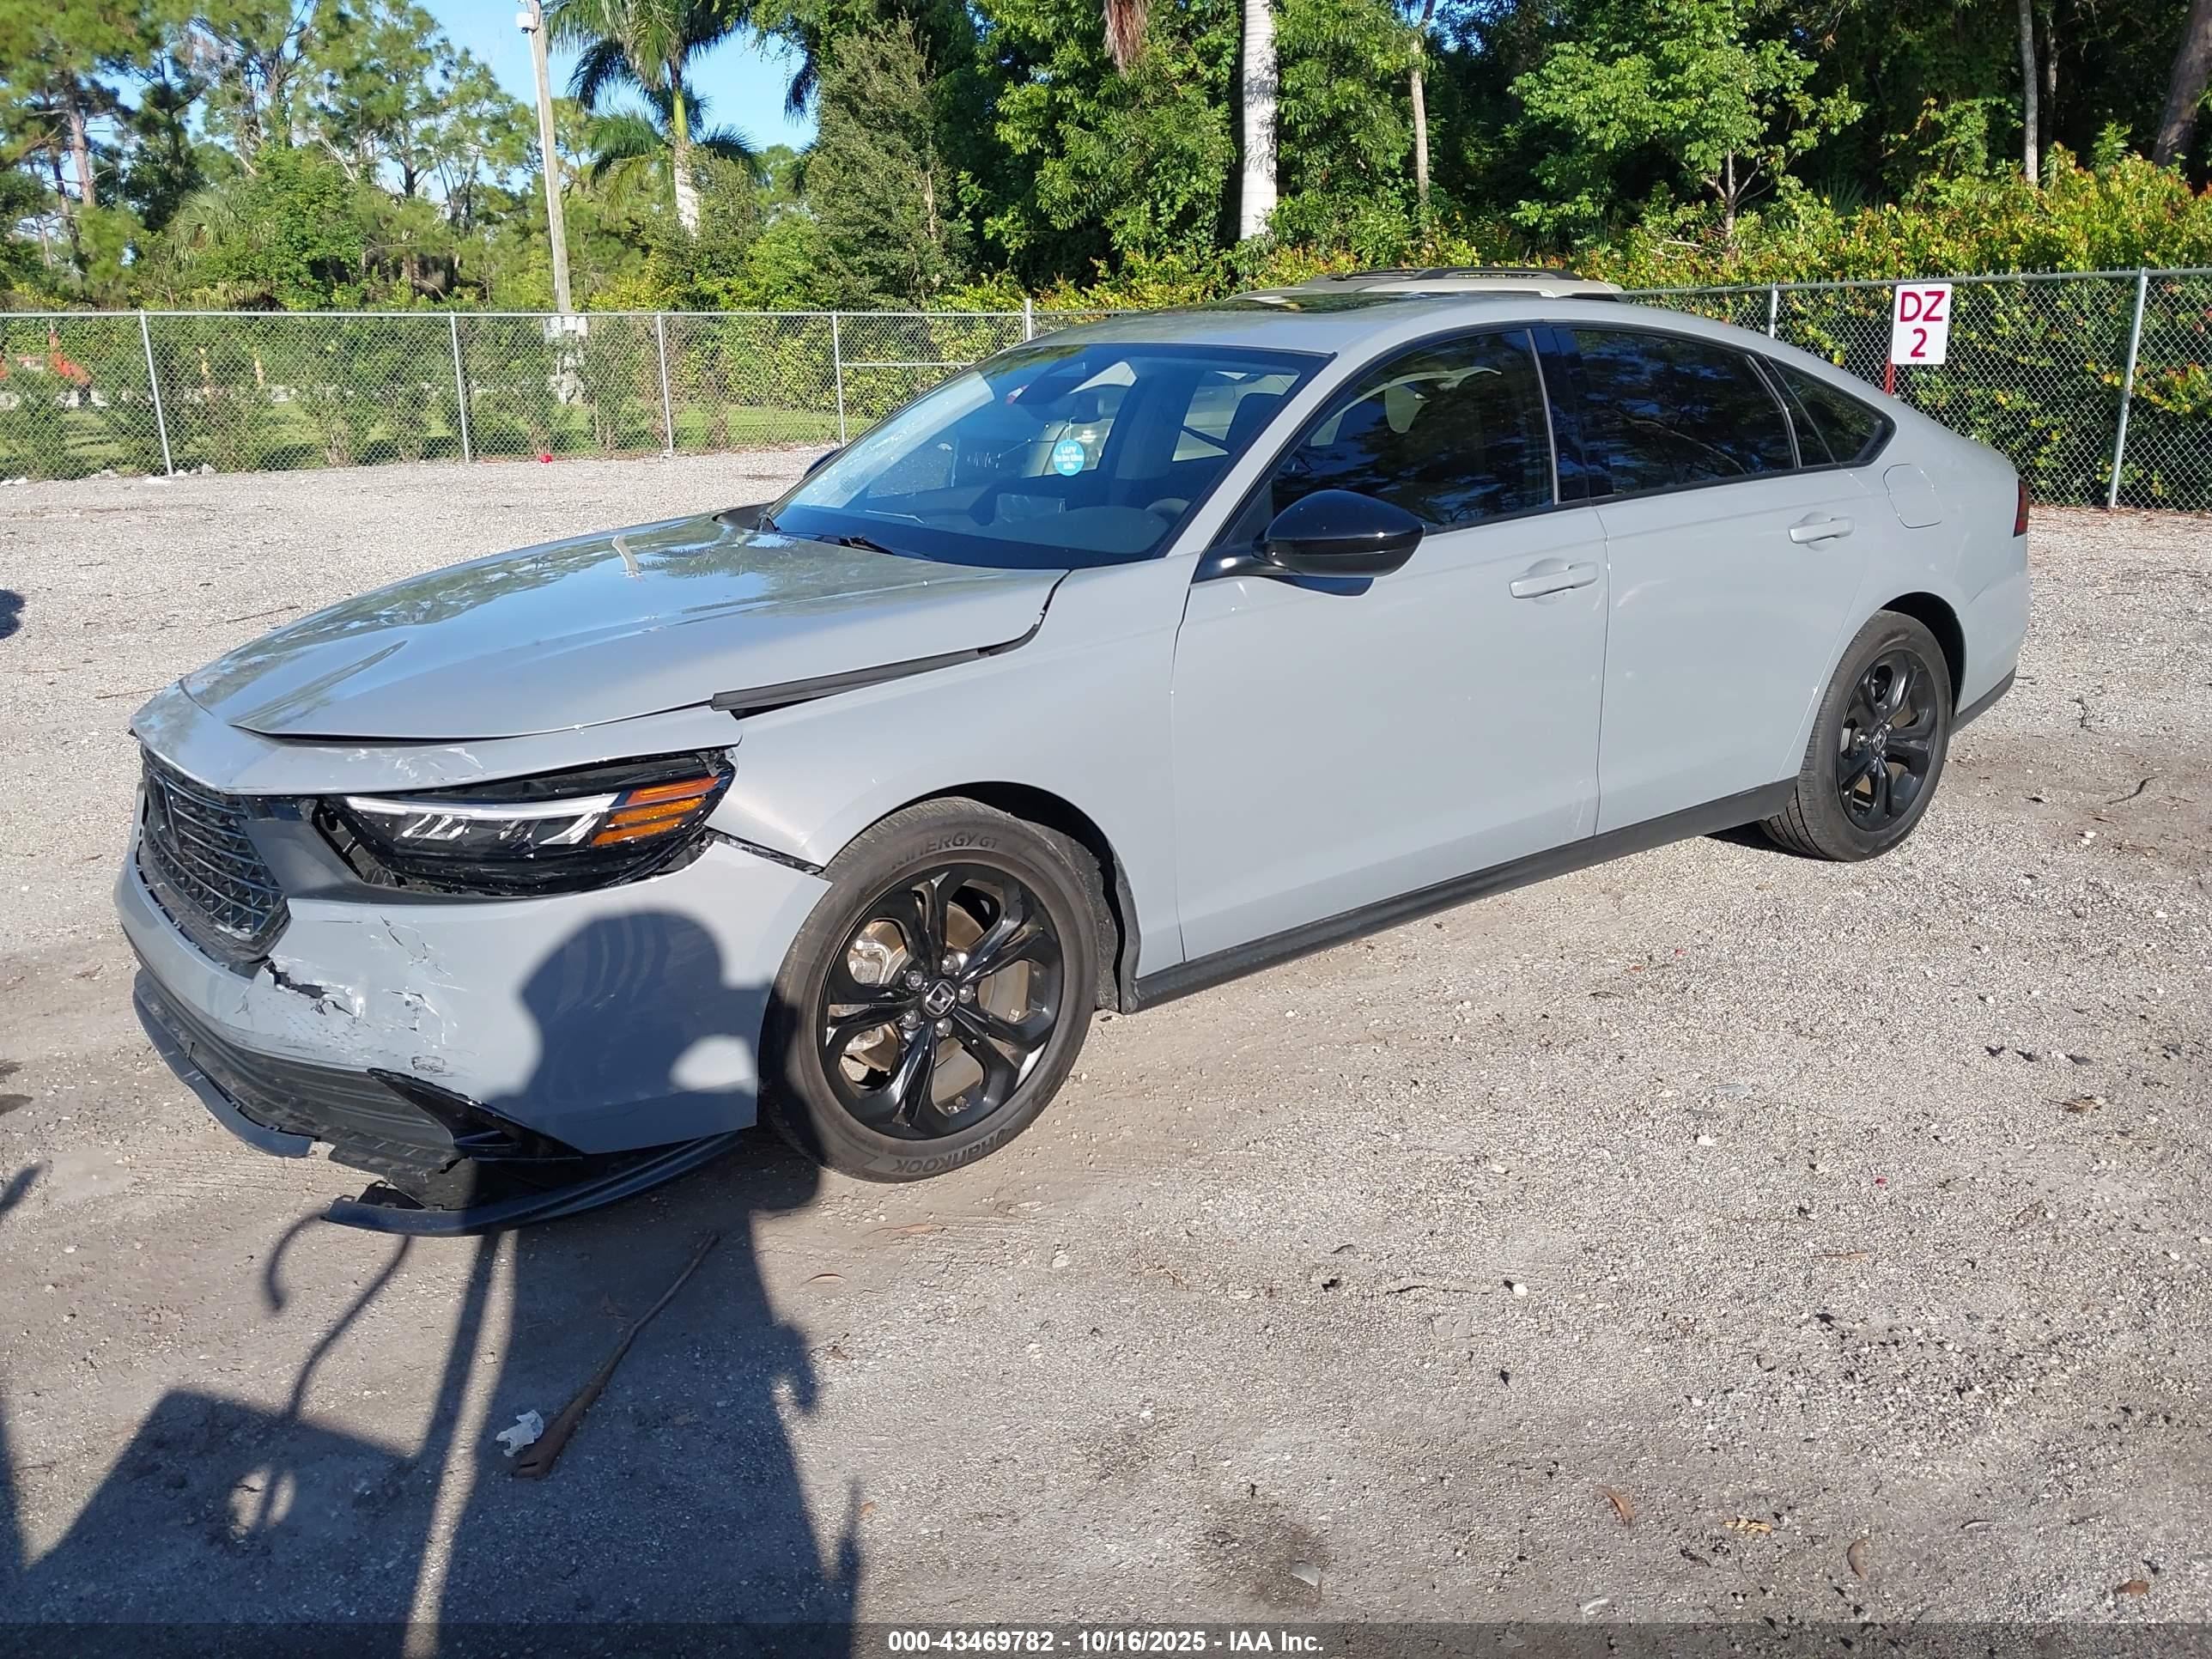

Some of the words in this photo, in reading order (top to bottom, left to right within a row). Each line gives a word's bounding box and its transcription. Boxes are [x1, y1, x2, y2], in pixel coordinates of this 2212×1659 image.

[1899, 290, 1945, 322] DZ
[1910, 327, 1928, 357] 2
[979, 836, 1001, 848] GT
